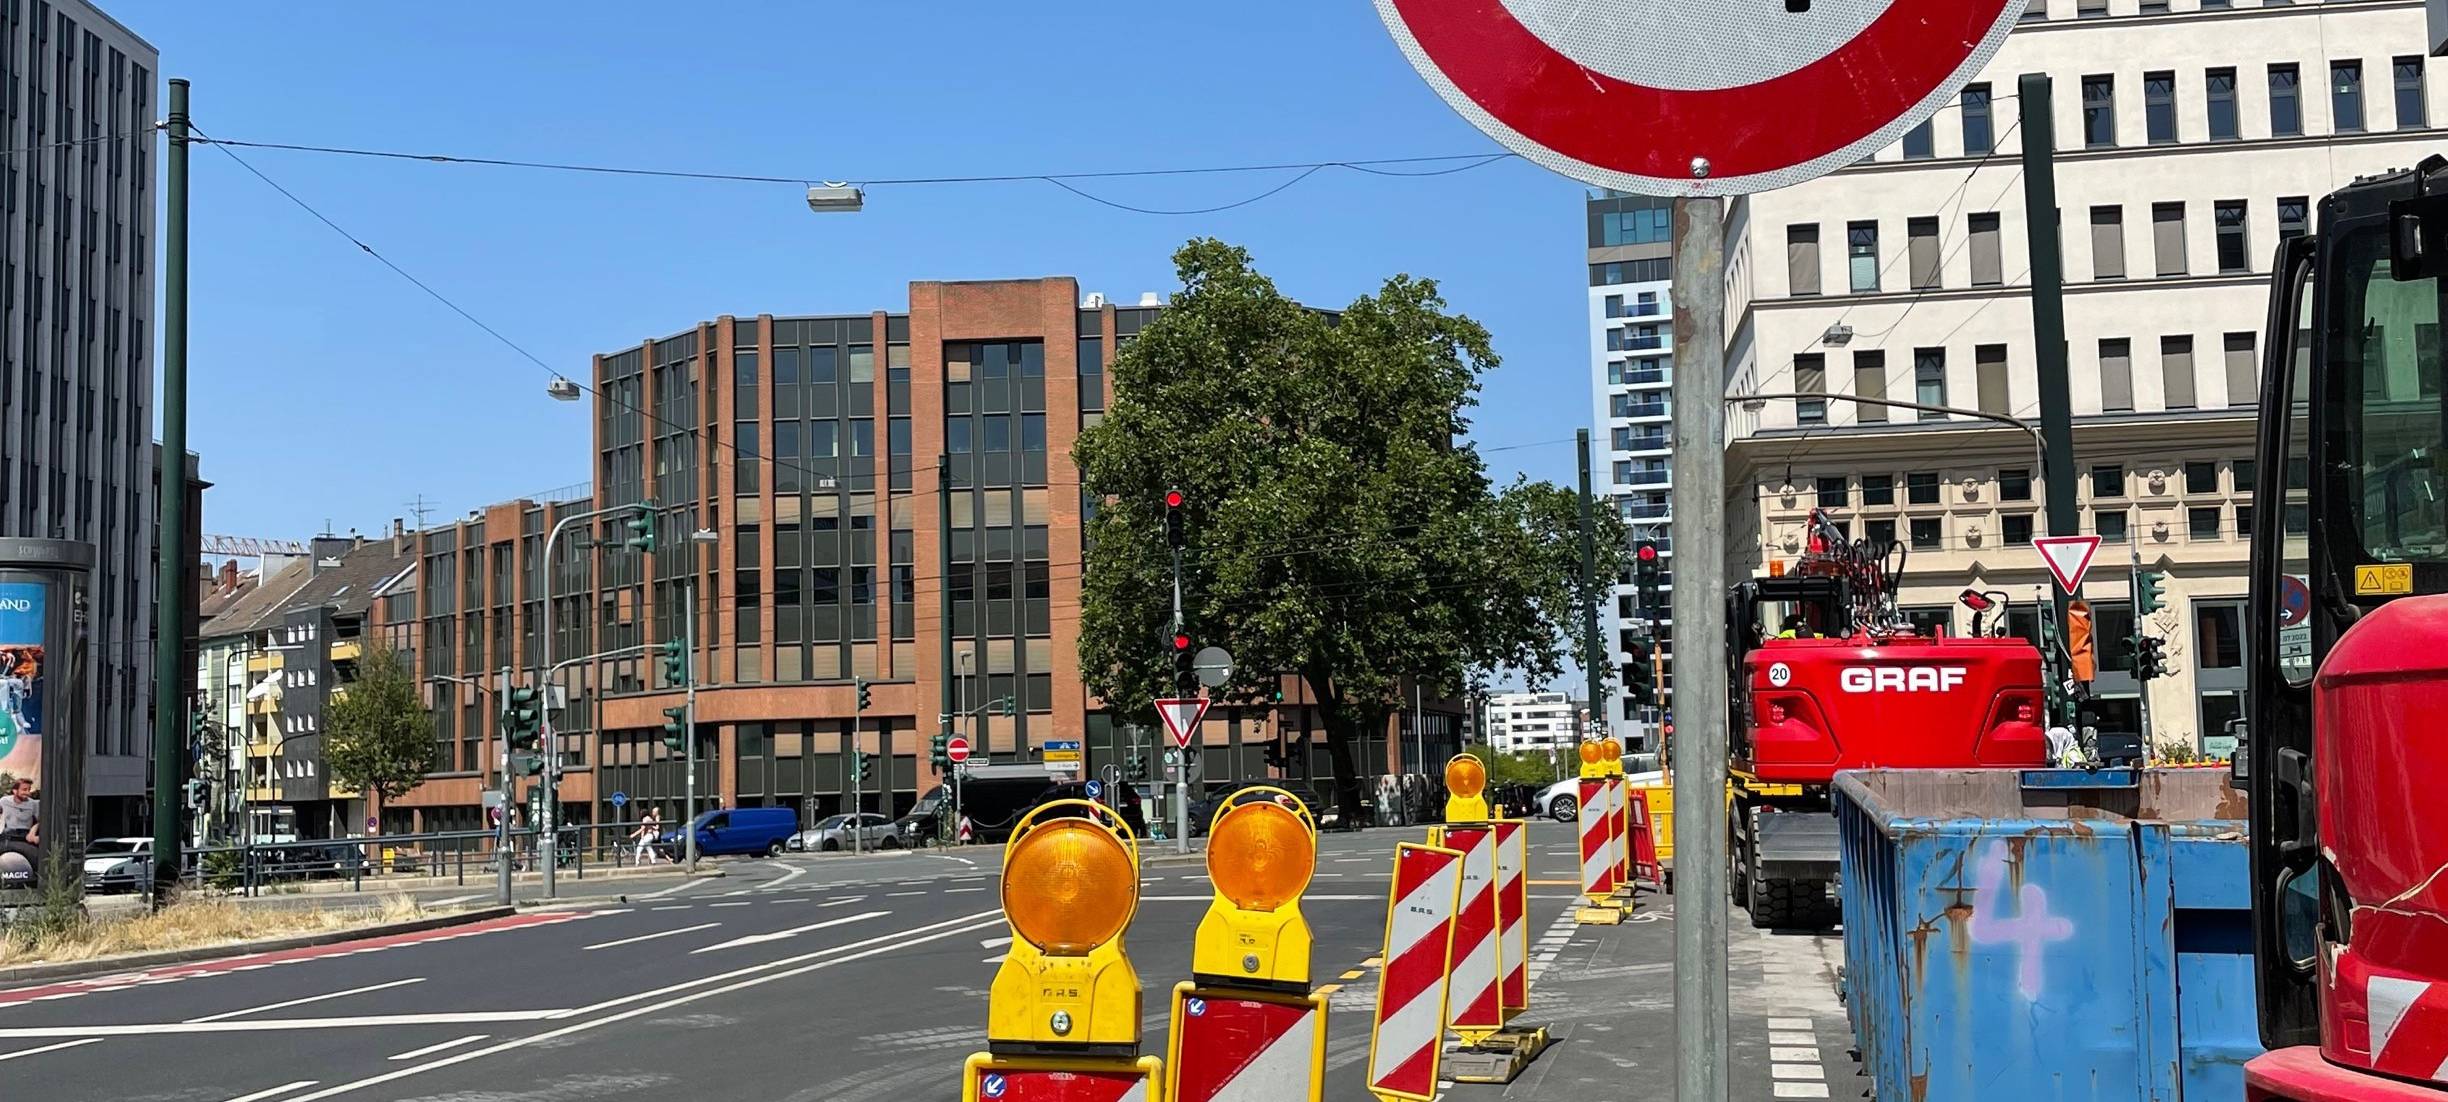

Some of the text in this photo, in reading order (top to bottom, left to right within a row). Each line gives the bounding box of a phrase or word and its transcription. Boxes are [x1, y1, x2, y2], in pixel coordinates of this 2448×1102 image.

[1771, 668, 1788, 681] 20
[1840, 666, 1967, 693] GRAF
[1967, 838, 2073, 1001] 4
